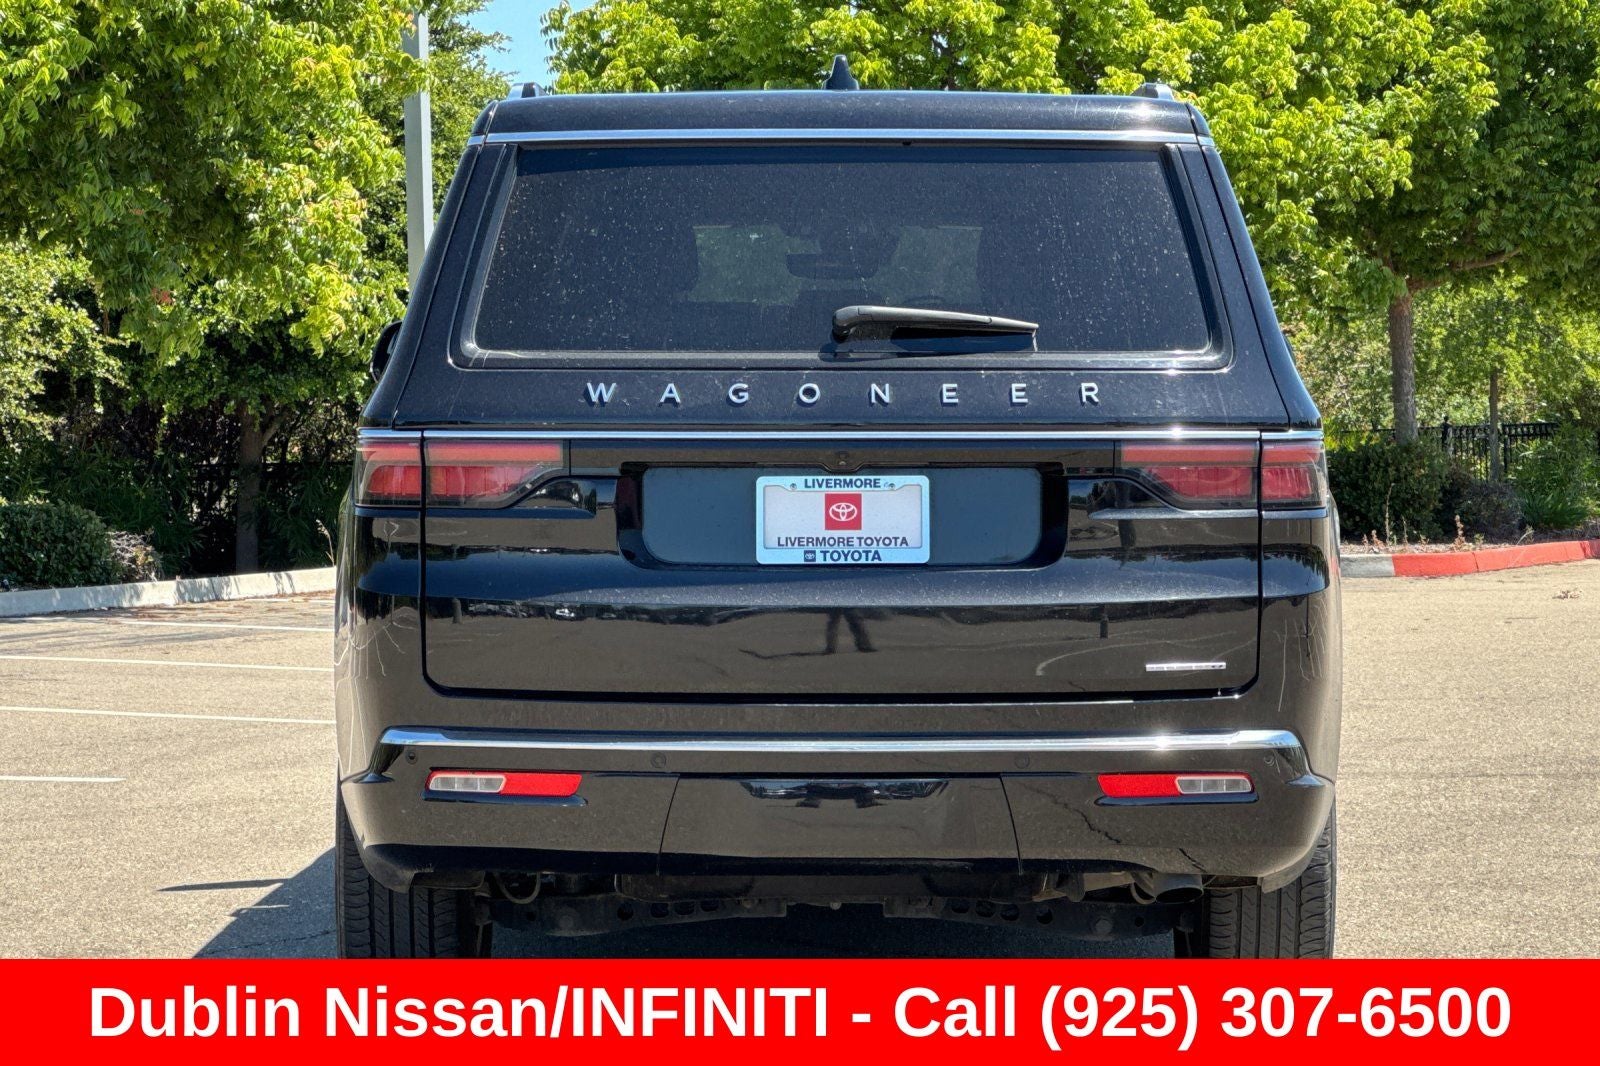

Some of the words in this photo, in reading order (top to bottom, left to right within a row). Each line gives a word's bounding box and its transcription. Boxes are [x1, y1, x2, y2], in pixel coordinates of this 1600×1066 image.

[585, 382, 1100, 403] WAGONEER
[804, 478, 881, 489] LIVERMORE
[777, 536, 856, 547] LIVERMORE
[857, 536, 909, 547] TOYOTA
[820, 550, 882, 562] TOYOTA
